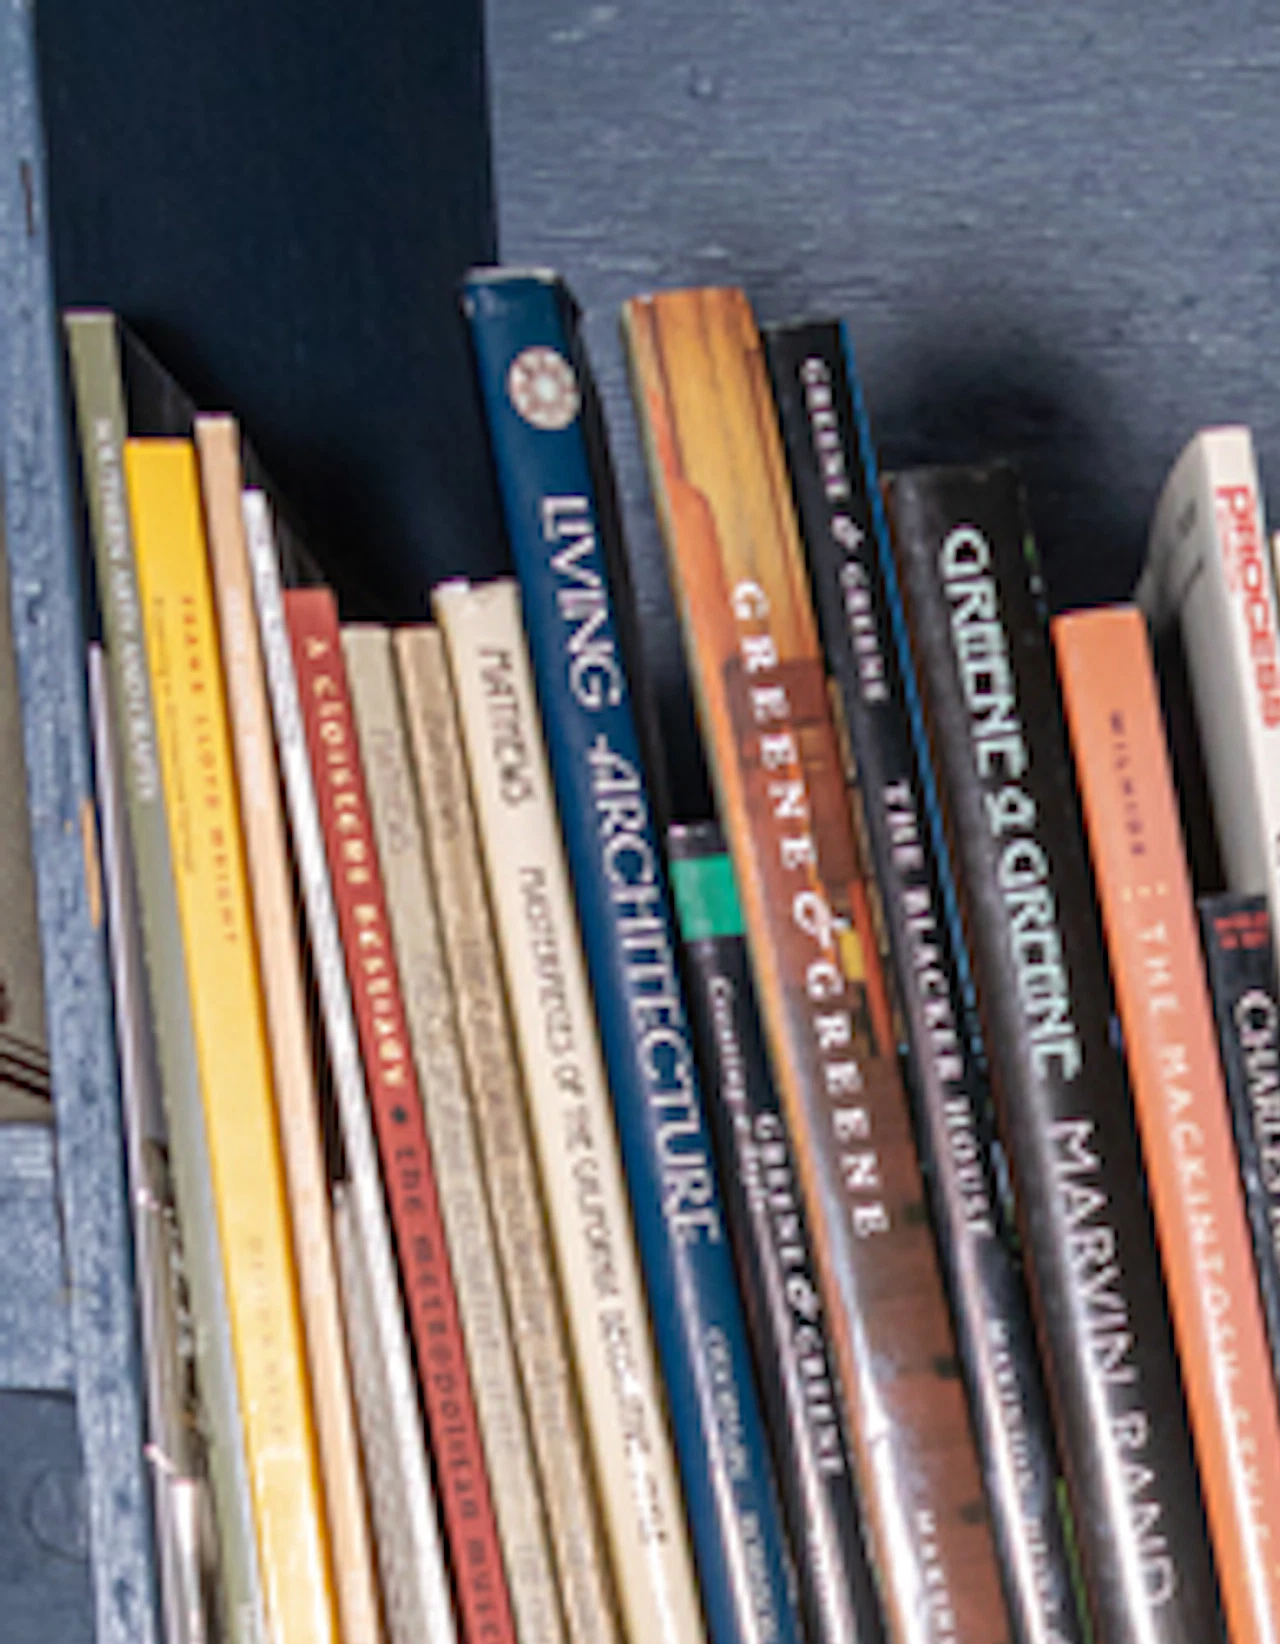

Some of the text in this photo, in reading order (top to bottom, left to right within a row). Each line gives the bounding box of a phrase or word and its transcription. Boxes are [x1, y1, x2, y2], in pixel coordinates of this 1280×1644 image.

[542, 491, 724, 1262] LIVING ARCHITECTURE
[726, 578, 896, 1252] GREENE & GREENE
[882, 782, 996, 1247] THE BLACKER HOUSE
[1045, 1116, 1180, 1617] MARVIN RAND
[1133, 919, 1247, 1390] THE MACKINTOSH
